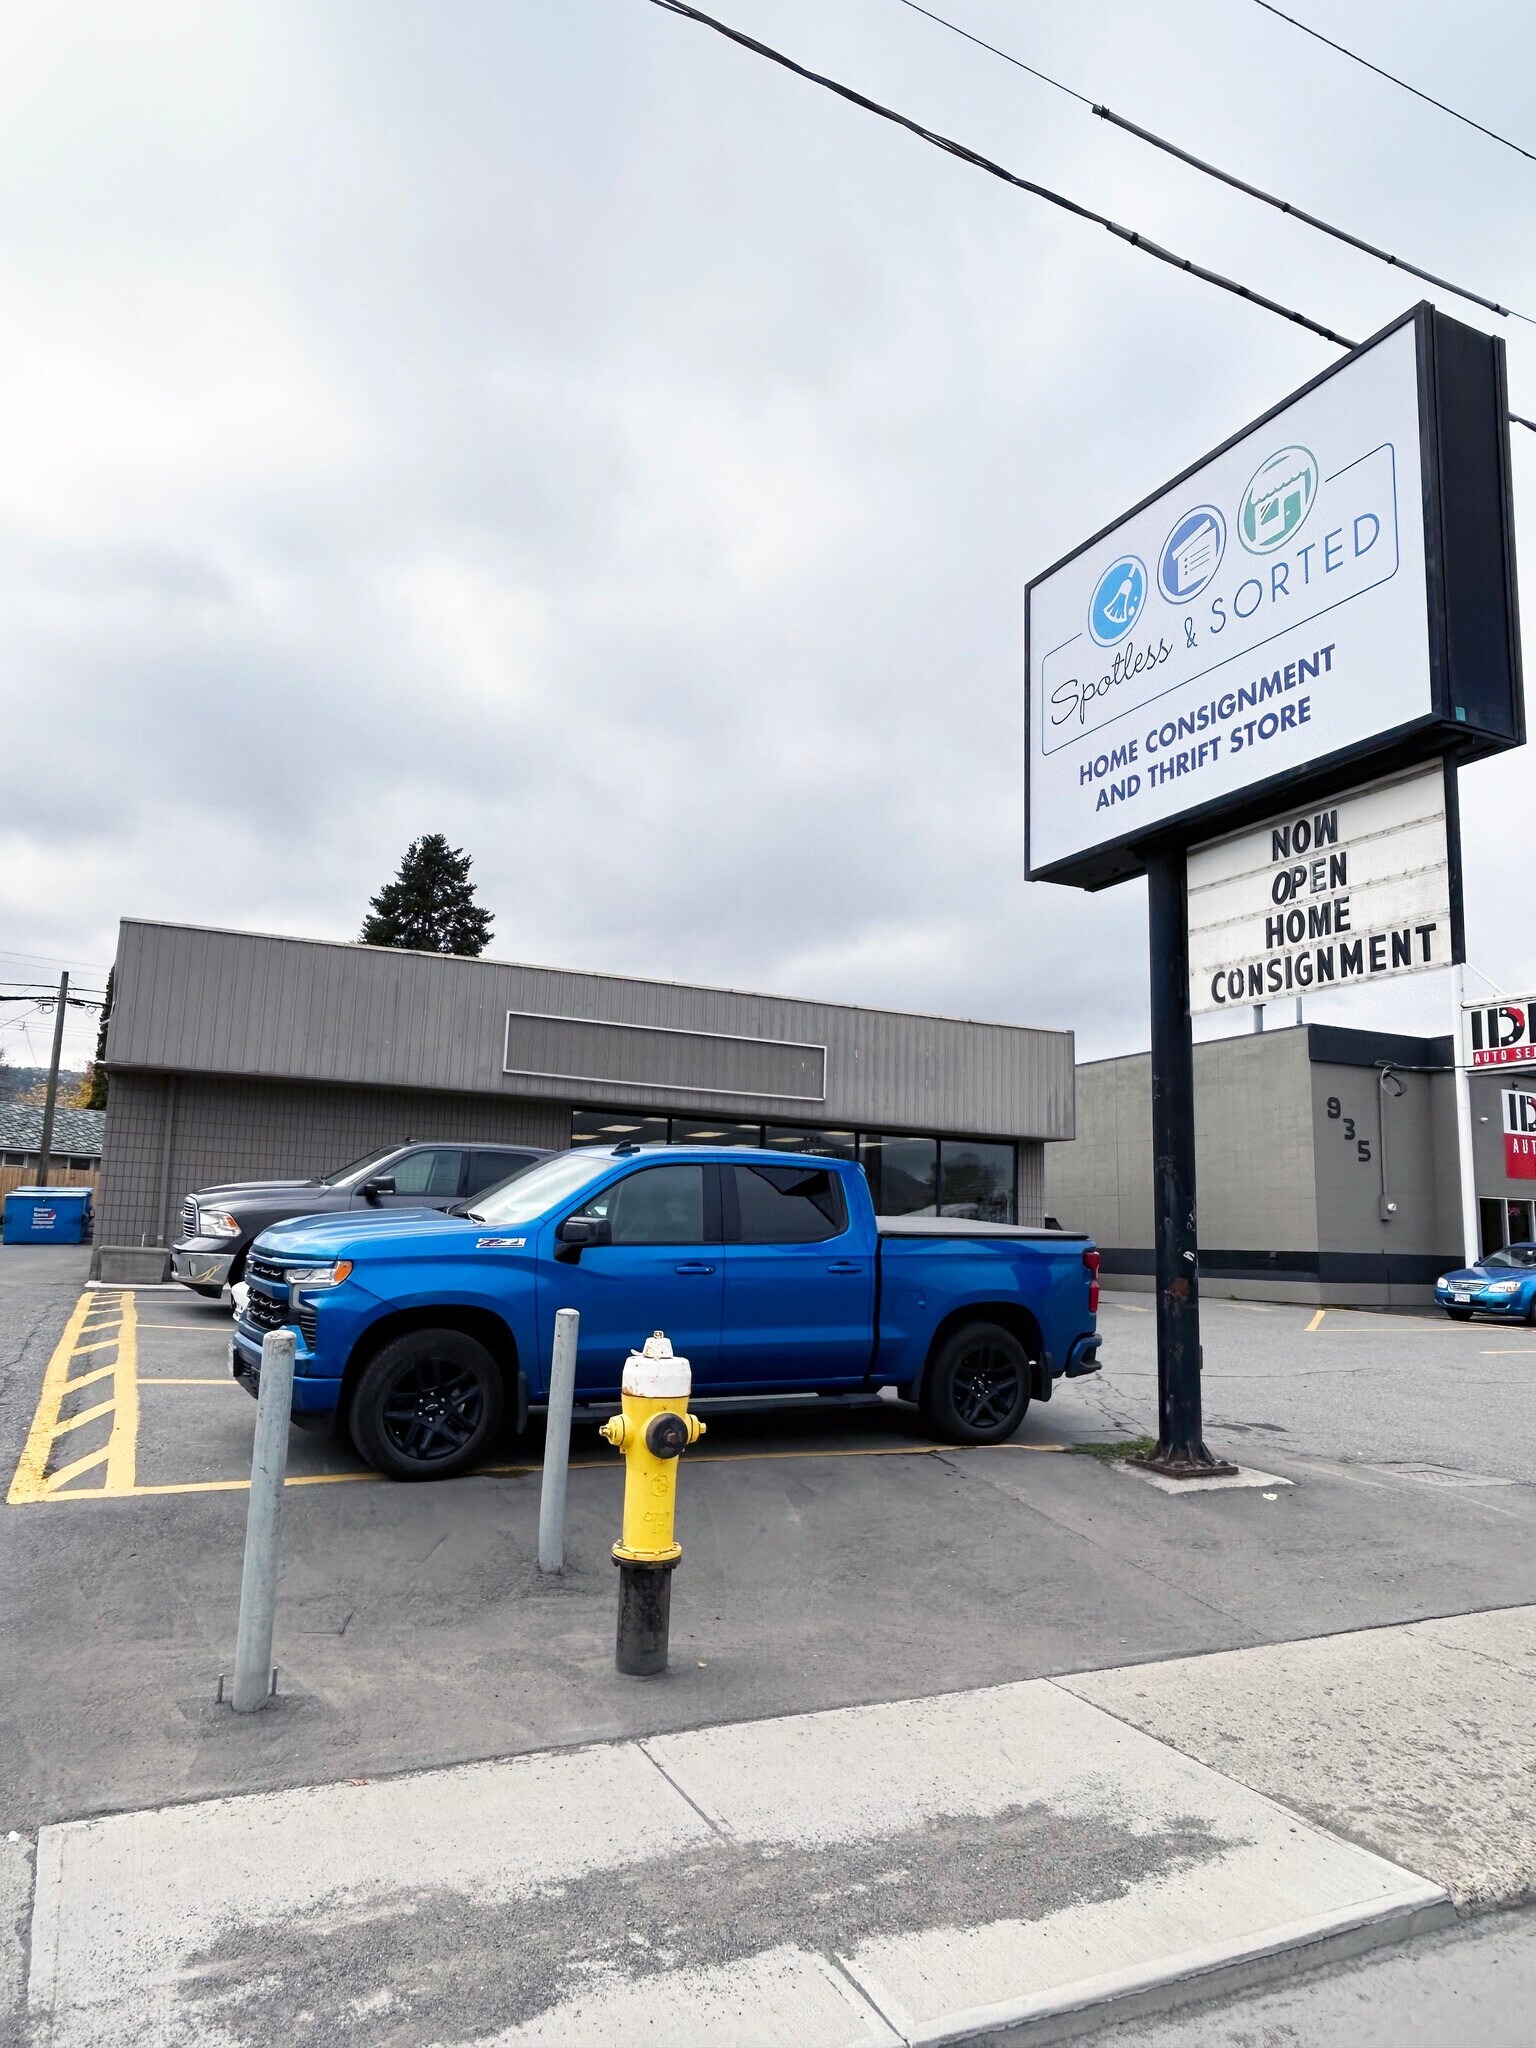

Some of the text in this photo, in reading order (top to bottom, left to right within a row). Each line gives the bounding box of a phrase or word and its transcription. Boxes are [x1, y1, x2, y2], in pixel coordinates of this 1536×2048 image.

[1051, 513, 1380, 726] Spotless & SORTED
[1079, 644, 1336, 785] HOME CONSIGNMENT
[1095, 696, 1312, 812] AND THRIFT STORE
[1272, 809, 1338, 862] NOW
[1271, 851, 1348, 905] OPEN
[1265, 896, 1351, 949] HOME
[1211, 923, 1436, 1003] CONSIGNMENT
[1474, 1050, 1507, 1064] AUTO
